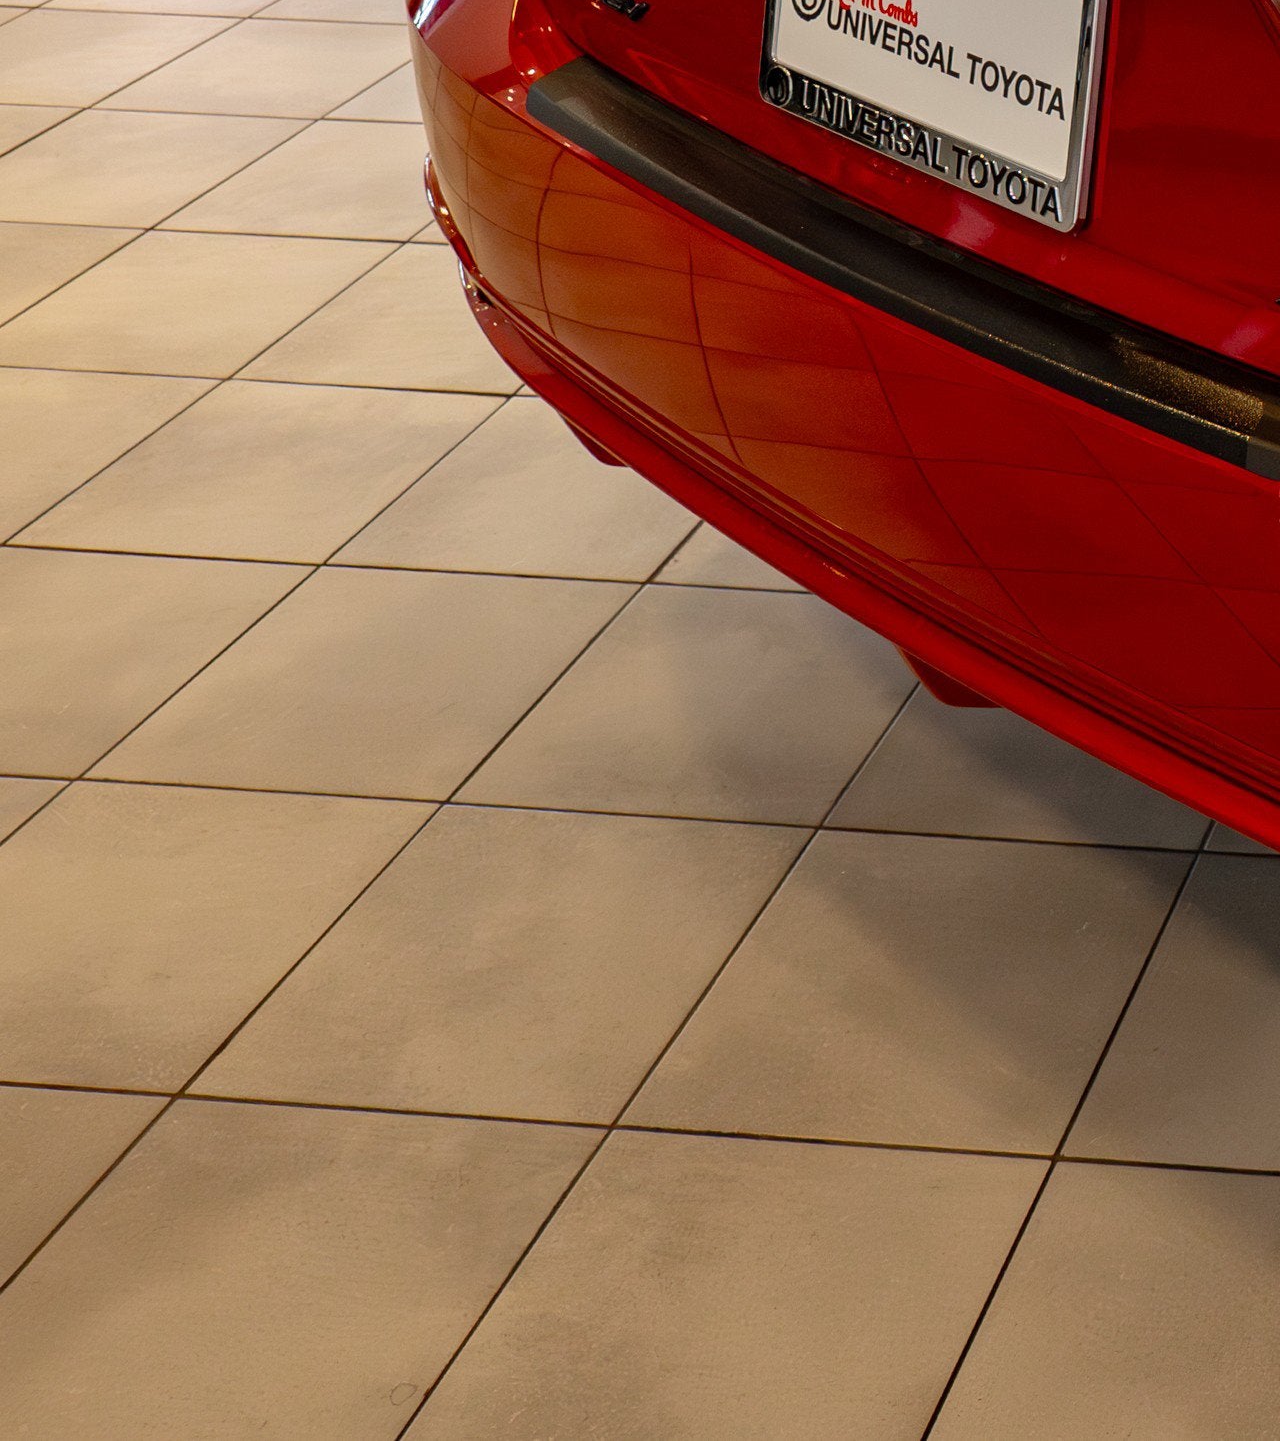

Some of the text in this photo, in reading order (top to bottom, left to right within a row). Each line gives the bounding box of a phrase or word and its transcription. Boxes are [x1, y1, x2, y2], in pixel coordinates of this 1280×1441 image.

[827, 0, 1065, 121] UNIVERSAL TOYOTA
[802, 78, 1063, 223] UNIVERSAL TOYOTA
